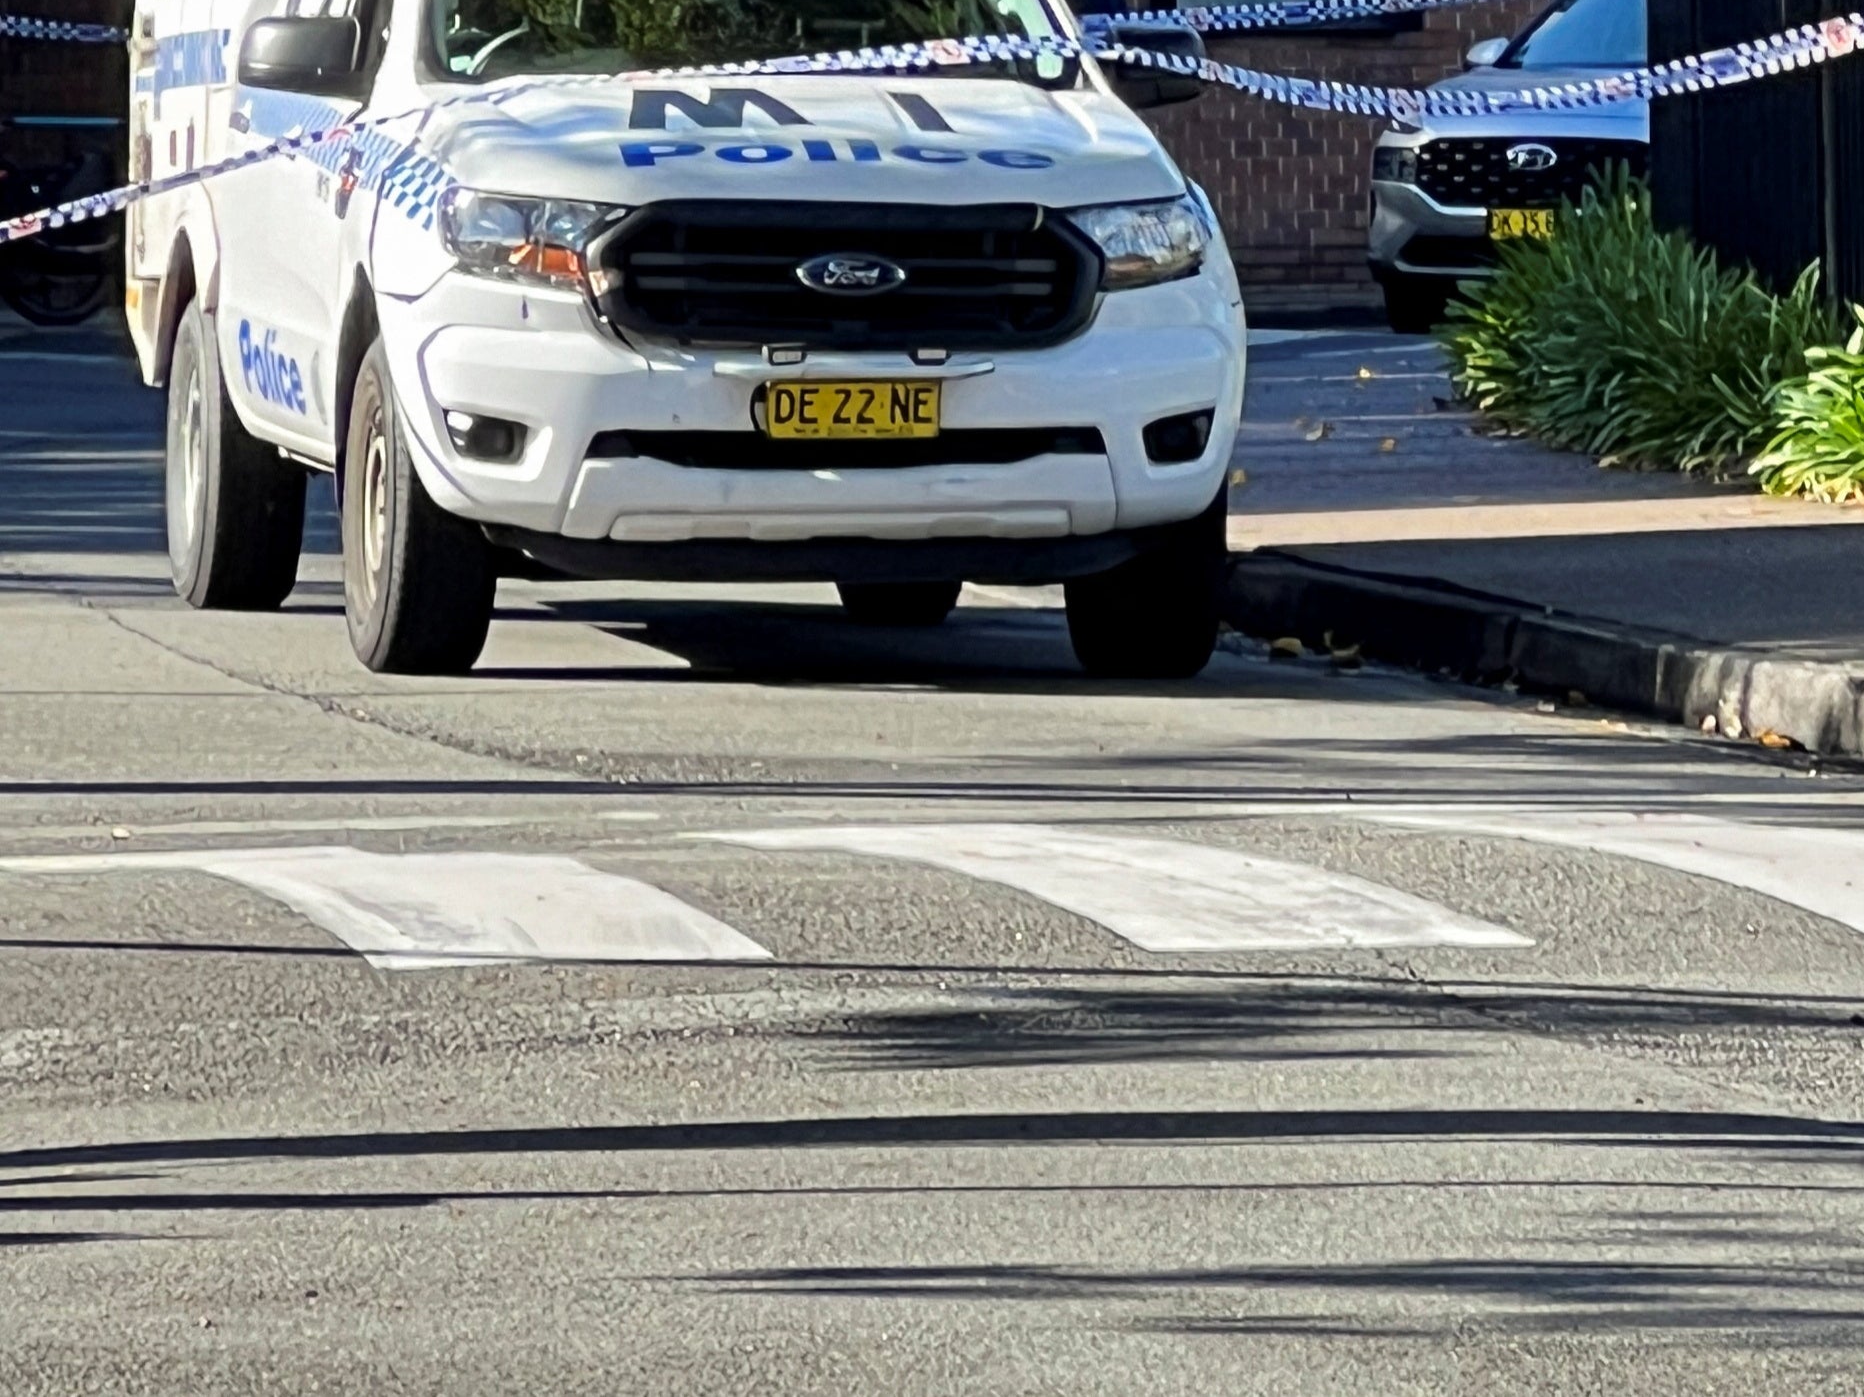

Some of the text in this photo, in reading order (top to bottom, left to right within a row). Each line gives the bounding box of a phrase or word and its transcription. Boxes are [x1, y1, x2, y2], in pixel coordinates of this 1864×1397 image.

[619, 139, 1056, 169] Police
[239, 318, 306, 416] Police
[774, 388, 820, 424] DE
[890, 385, 933, 424] NE
